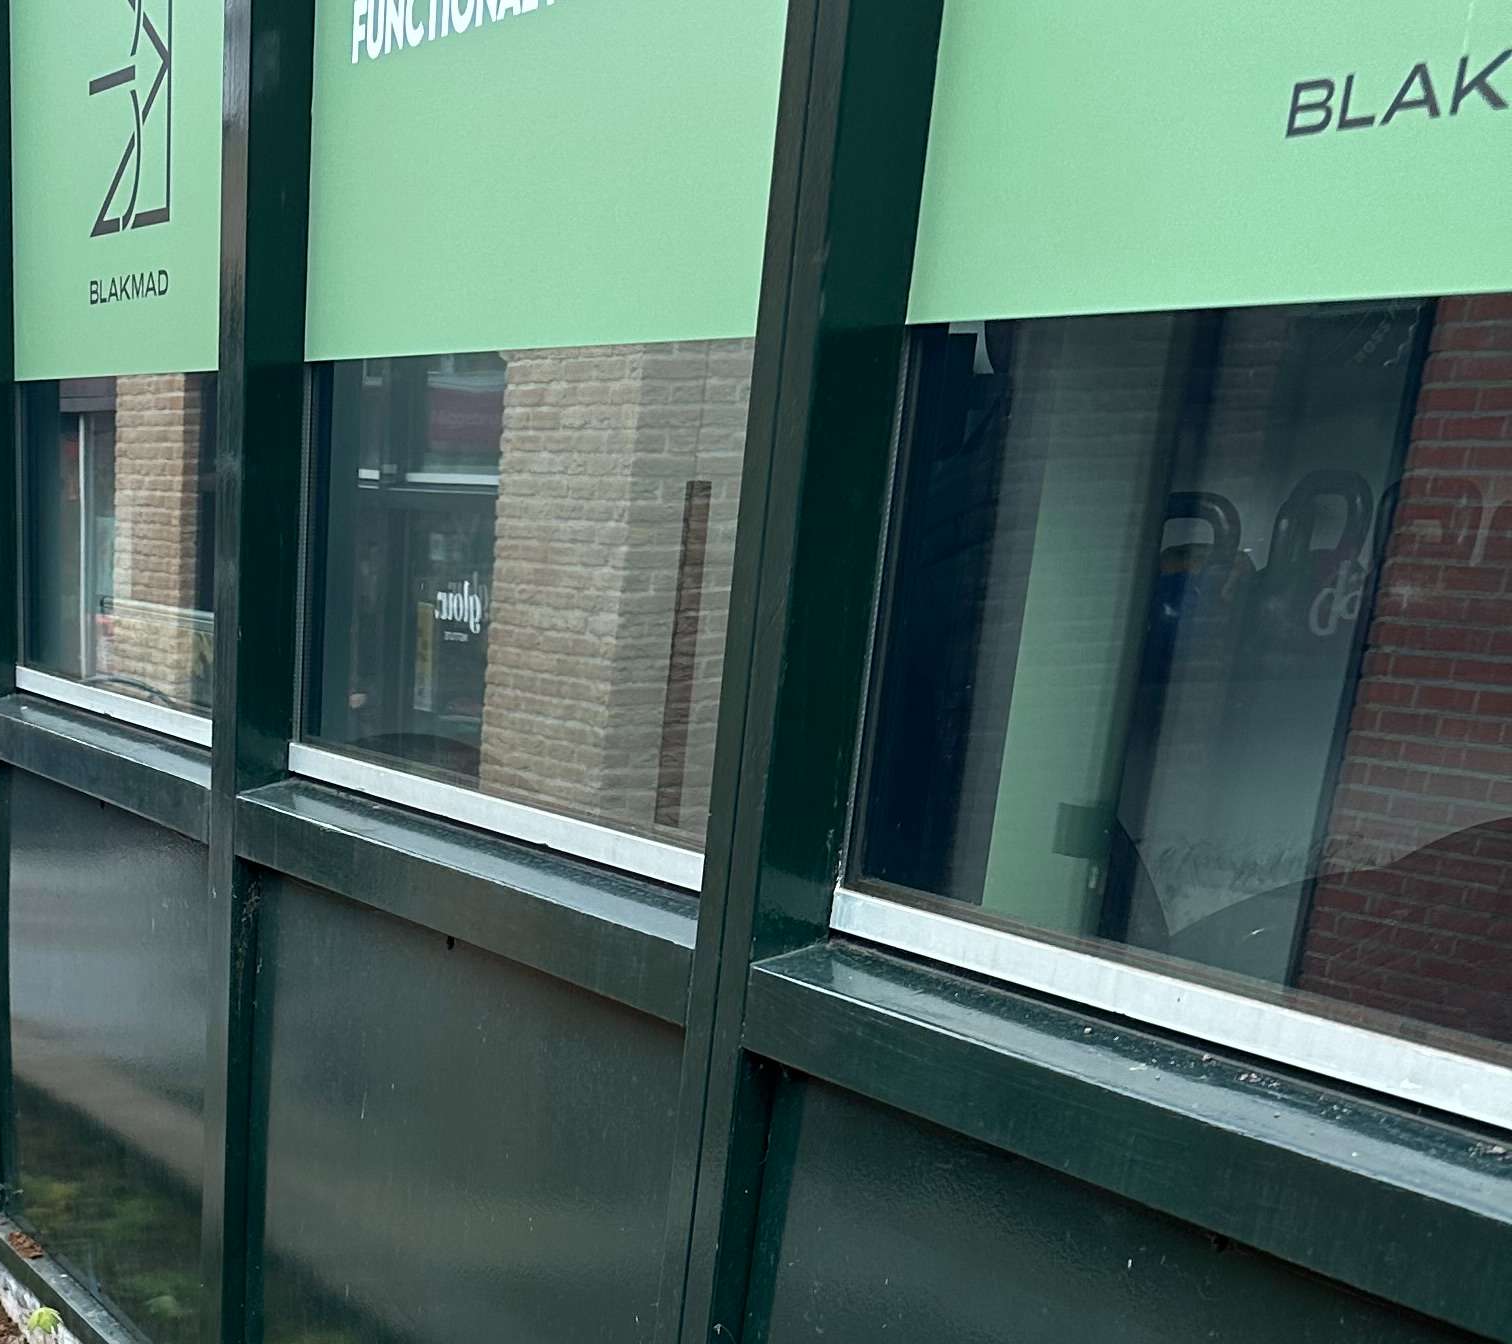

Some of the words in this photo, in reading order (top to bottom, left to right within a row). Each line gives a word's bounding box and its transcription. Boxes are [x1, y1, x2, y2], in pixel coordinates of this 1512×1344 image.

[352, 0, 539, 64] FUNCTIO
[1285, 48, 1512, 138] BLAK
[90, 269, 169, 305] BLAKMAD
